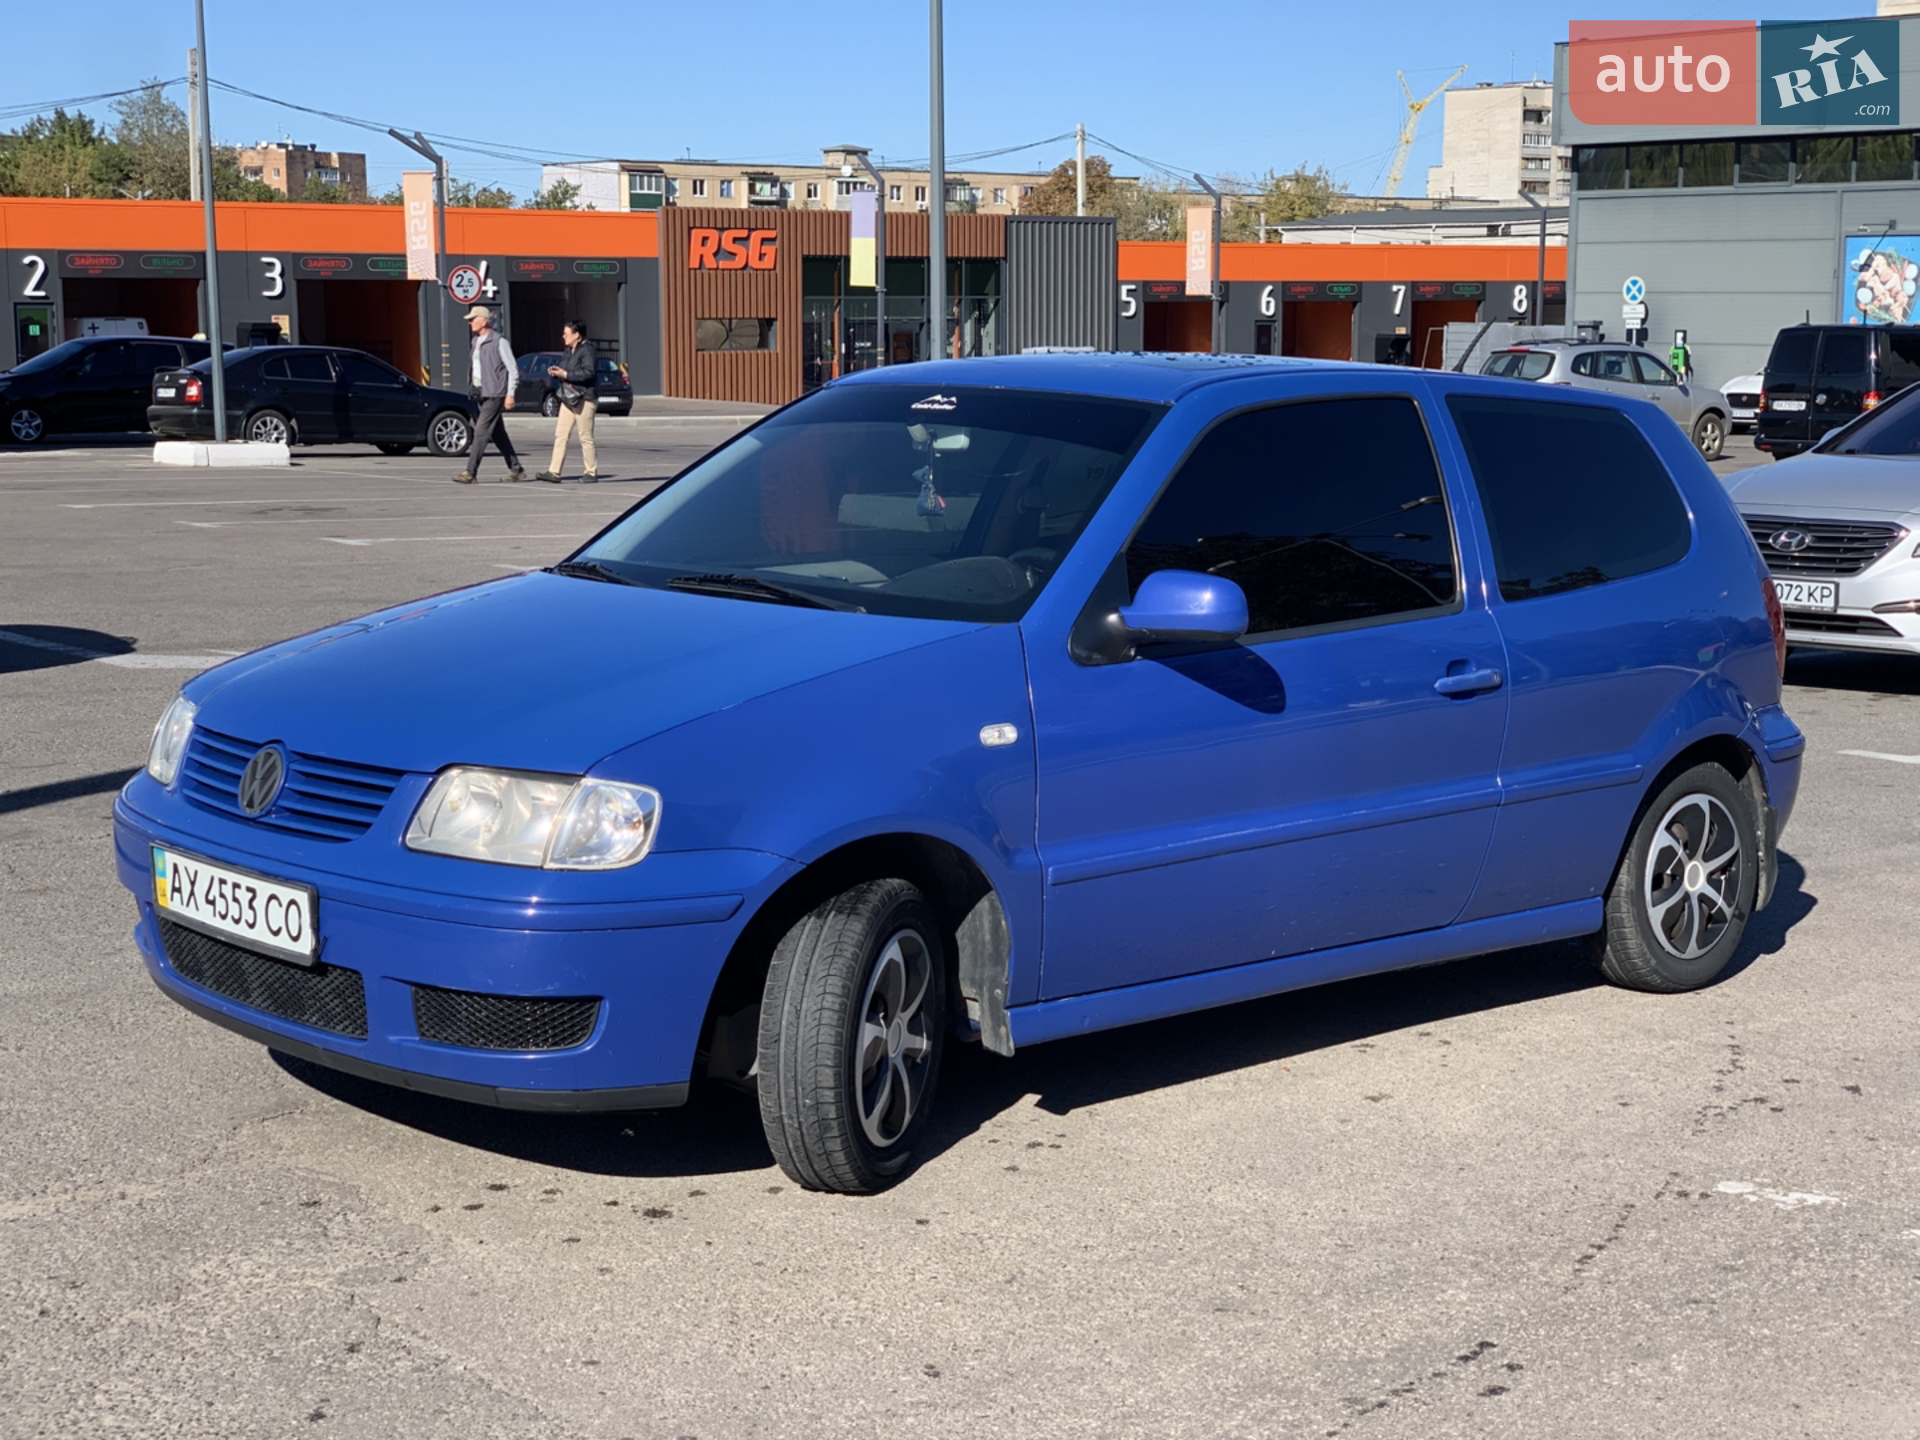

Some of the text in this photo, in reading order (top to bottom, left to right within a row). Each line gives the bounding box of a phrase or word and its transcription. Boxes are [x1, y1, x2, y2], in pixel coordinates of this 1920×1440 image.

[73, 256, 117, 266] ЗАЙНЯТО
[152, 258, 184, 266] ВІЛЬНО
[689, 228, 777, 270] RSG
[22, 255, 46, 296] 2
[260, 257, 283, 297] 3
[480, 260, 498, 298] 4
[1121, 285, 1137, 317] 5
[1260, 285, 1276, 317] 6
[1392, 285, 1406, 315] 7
[1513, 285, 1528, 313] 8
[1807, 585, 1833, 604] KP
[170, 862, 302, 943] AX 4553 CO
